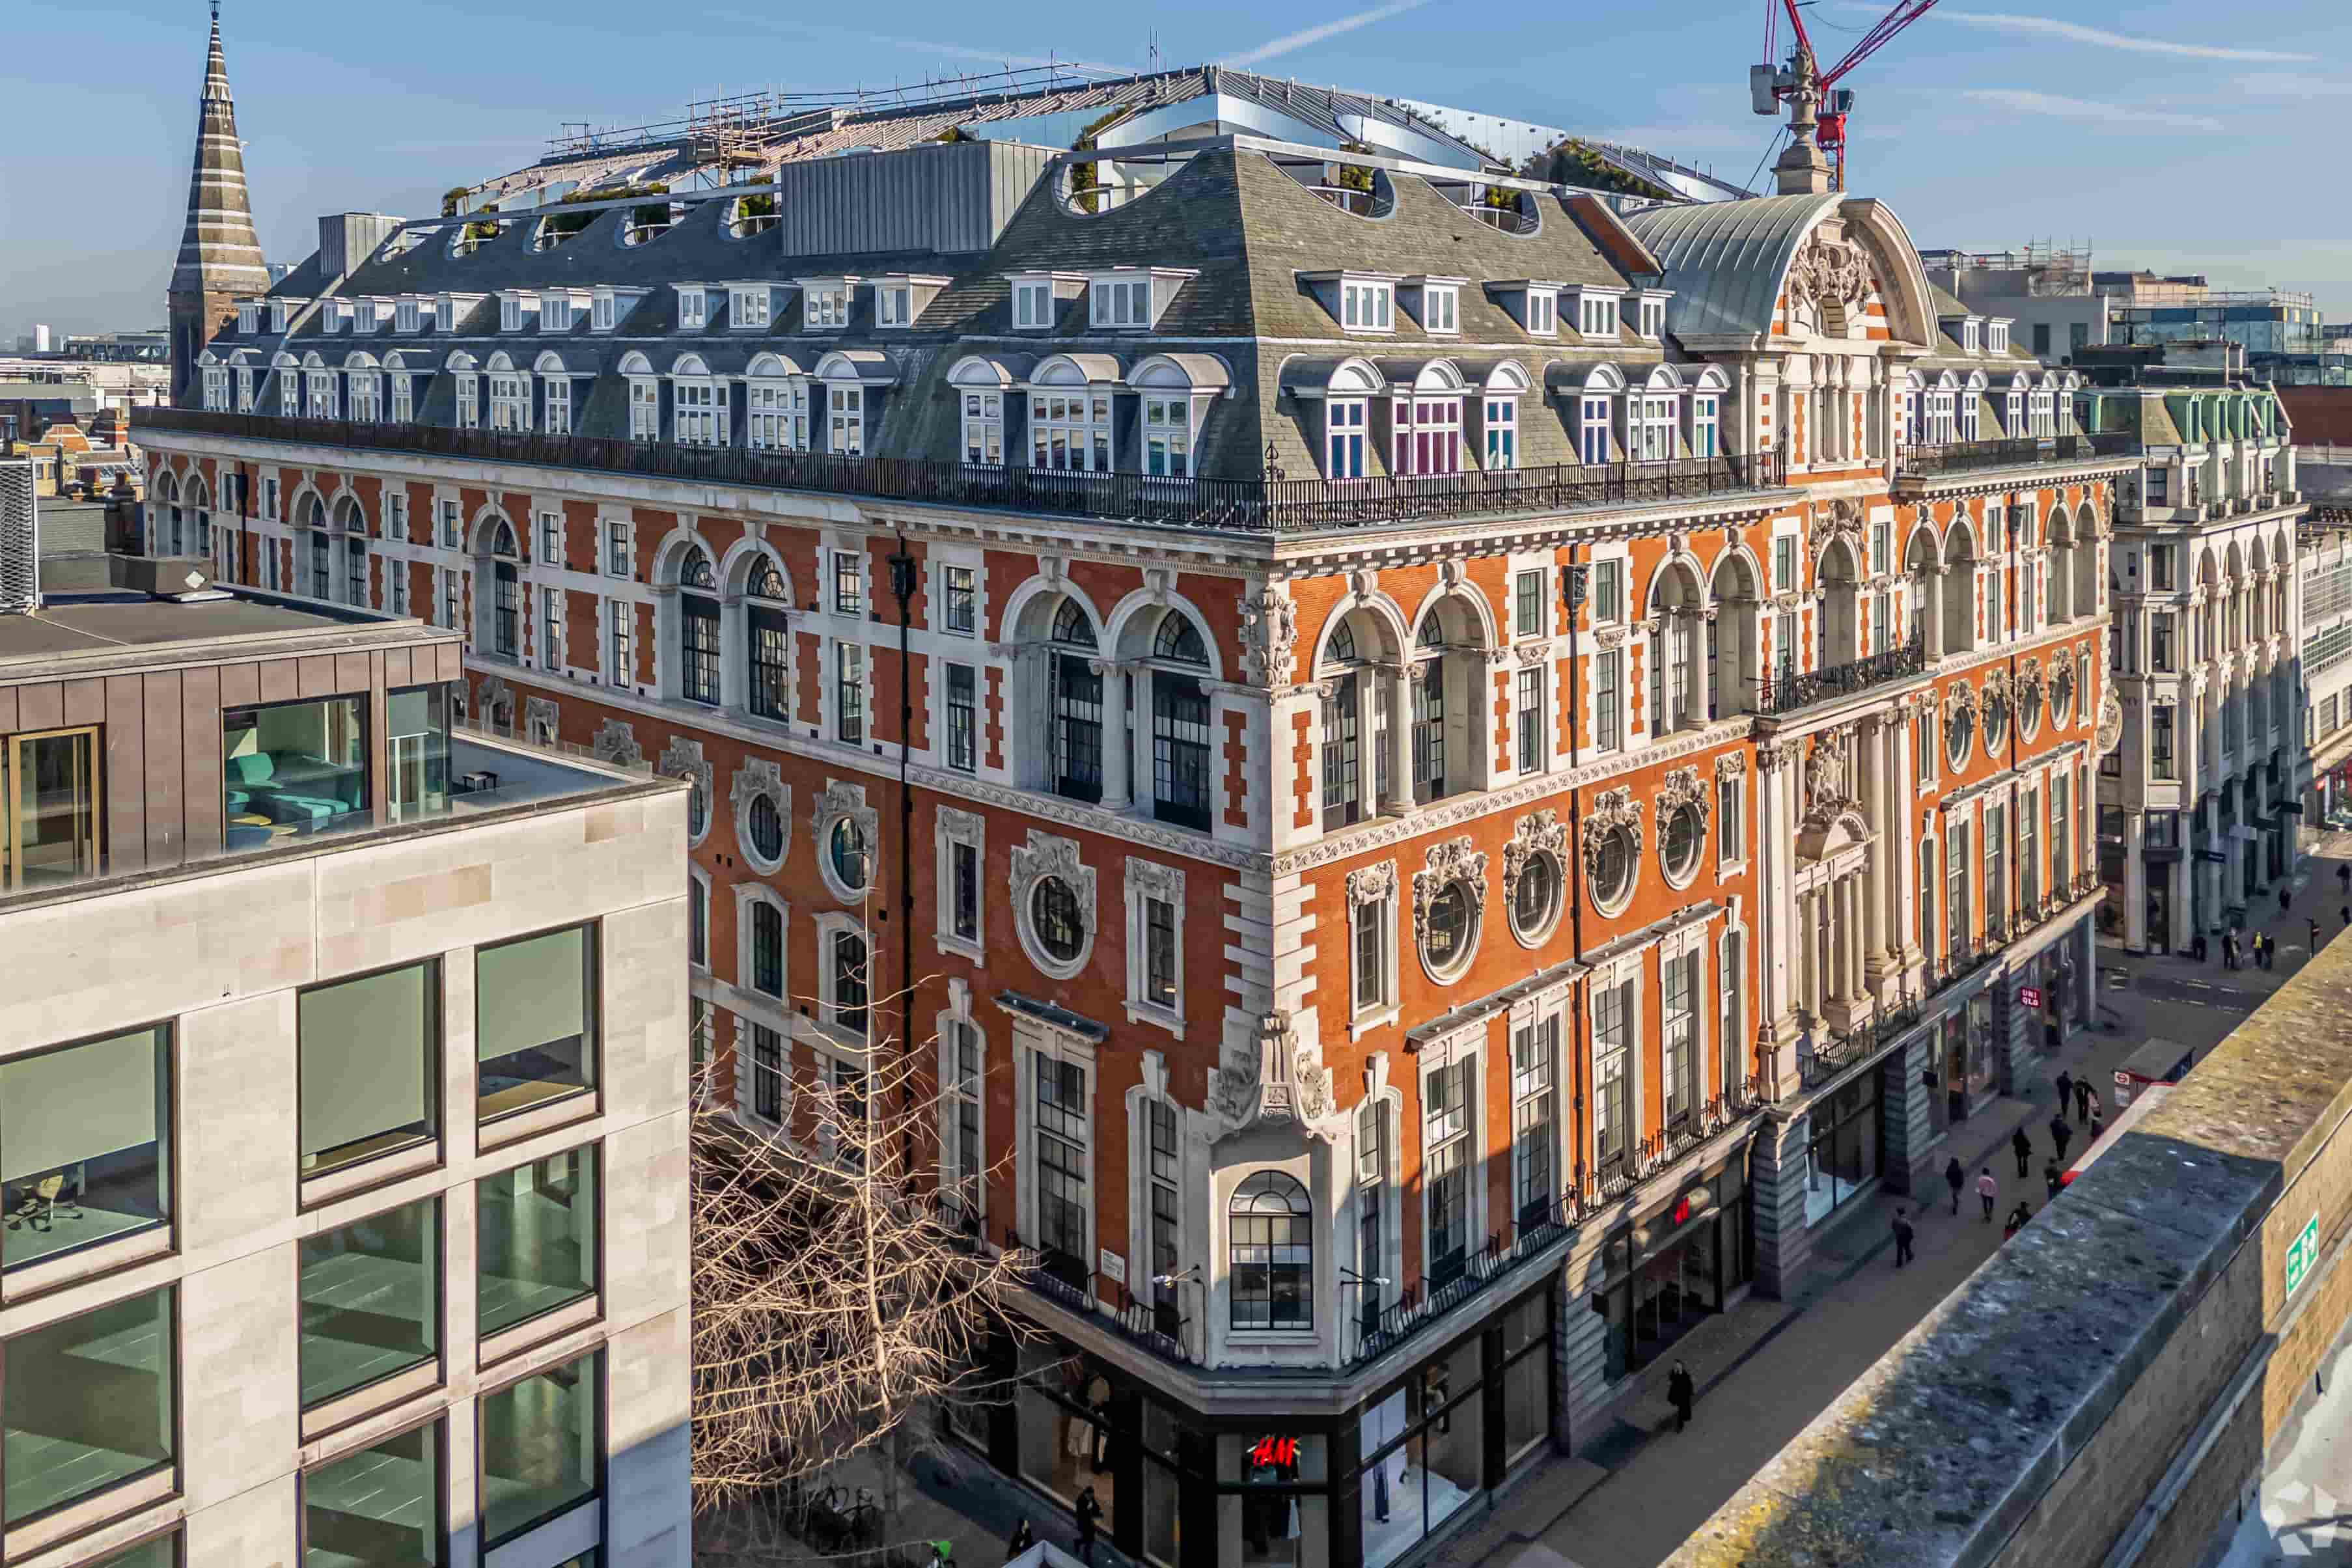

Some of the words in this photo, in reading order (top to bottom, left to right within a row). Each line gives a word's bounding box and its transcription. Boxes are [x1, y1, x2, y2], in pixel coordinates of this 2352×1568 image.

[2022, 989, 2037, 998] UNI
[2022, 997, 2038, 1006] QLO
[1252, 1437, 1295, 1466] H&M
